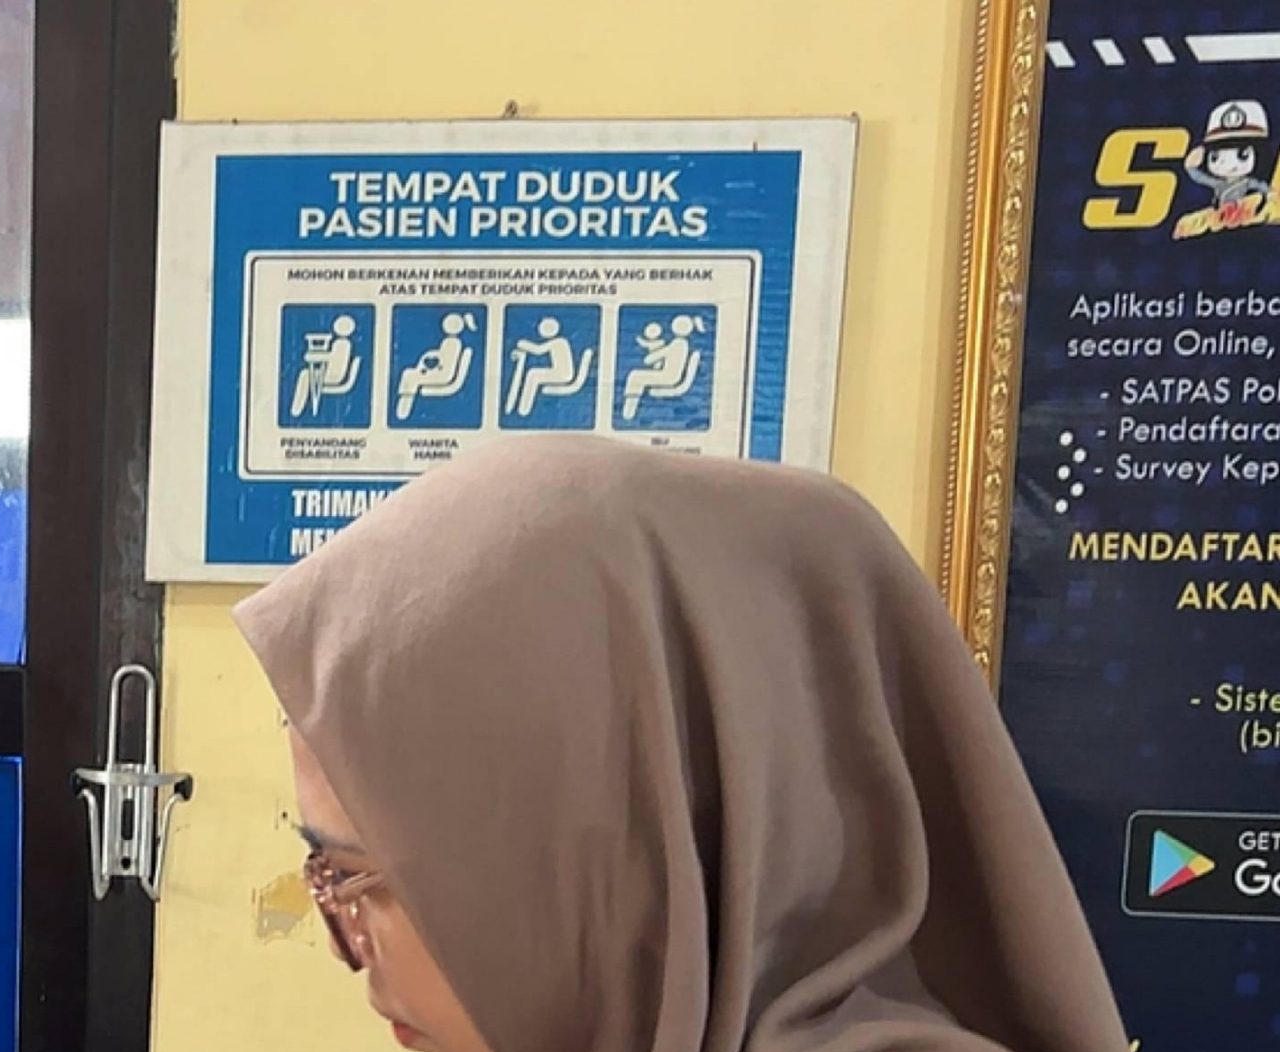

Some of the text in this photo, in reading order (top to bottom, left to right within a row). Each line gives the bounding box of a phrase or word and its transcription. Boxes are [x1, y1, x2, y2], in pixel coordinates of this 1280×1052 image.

[330, 170, 681, 203] TEMPAT DUDUK
[299, 206, 708, 238] PASIEN PRIORITAS
[287, 269, 713, 281] MOHON BERKENAN MEMBERIKAN KEPADA YANG BERHAK
[379, 284, 618, 295] ATAS TEMPAT DUDUK PRIORITAS
[1070, 293, 1183, 325] Aplikasi
[1067, 328, 1275, 360] secara Online,
[1121, 377, 1231, 404] SATPAS
[285, 449, 360, 460] DISABILITAS
[408, 438, 459, 449] WANITA
[1115, 456, 1211, 486] Survey
[291, 489, 393, 517] TRIMAK
[1069, 531, 1280, 562] MENDAFTAR
